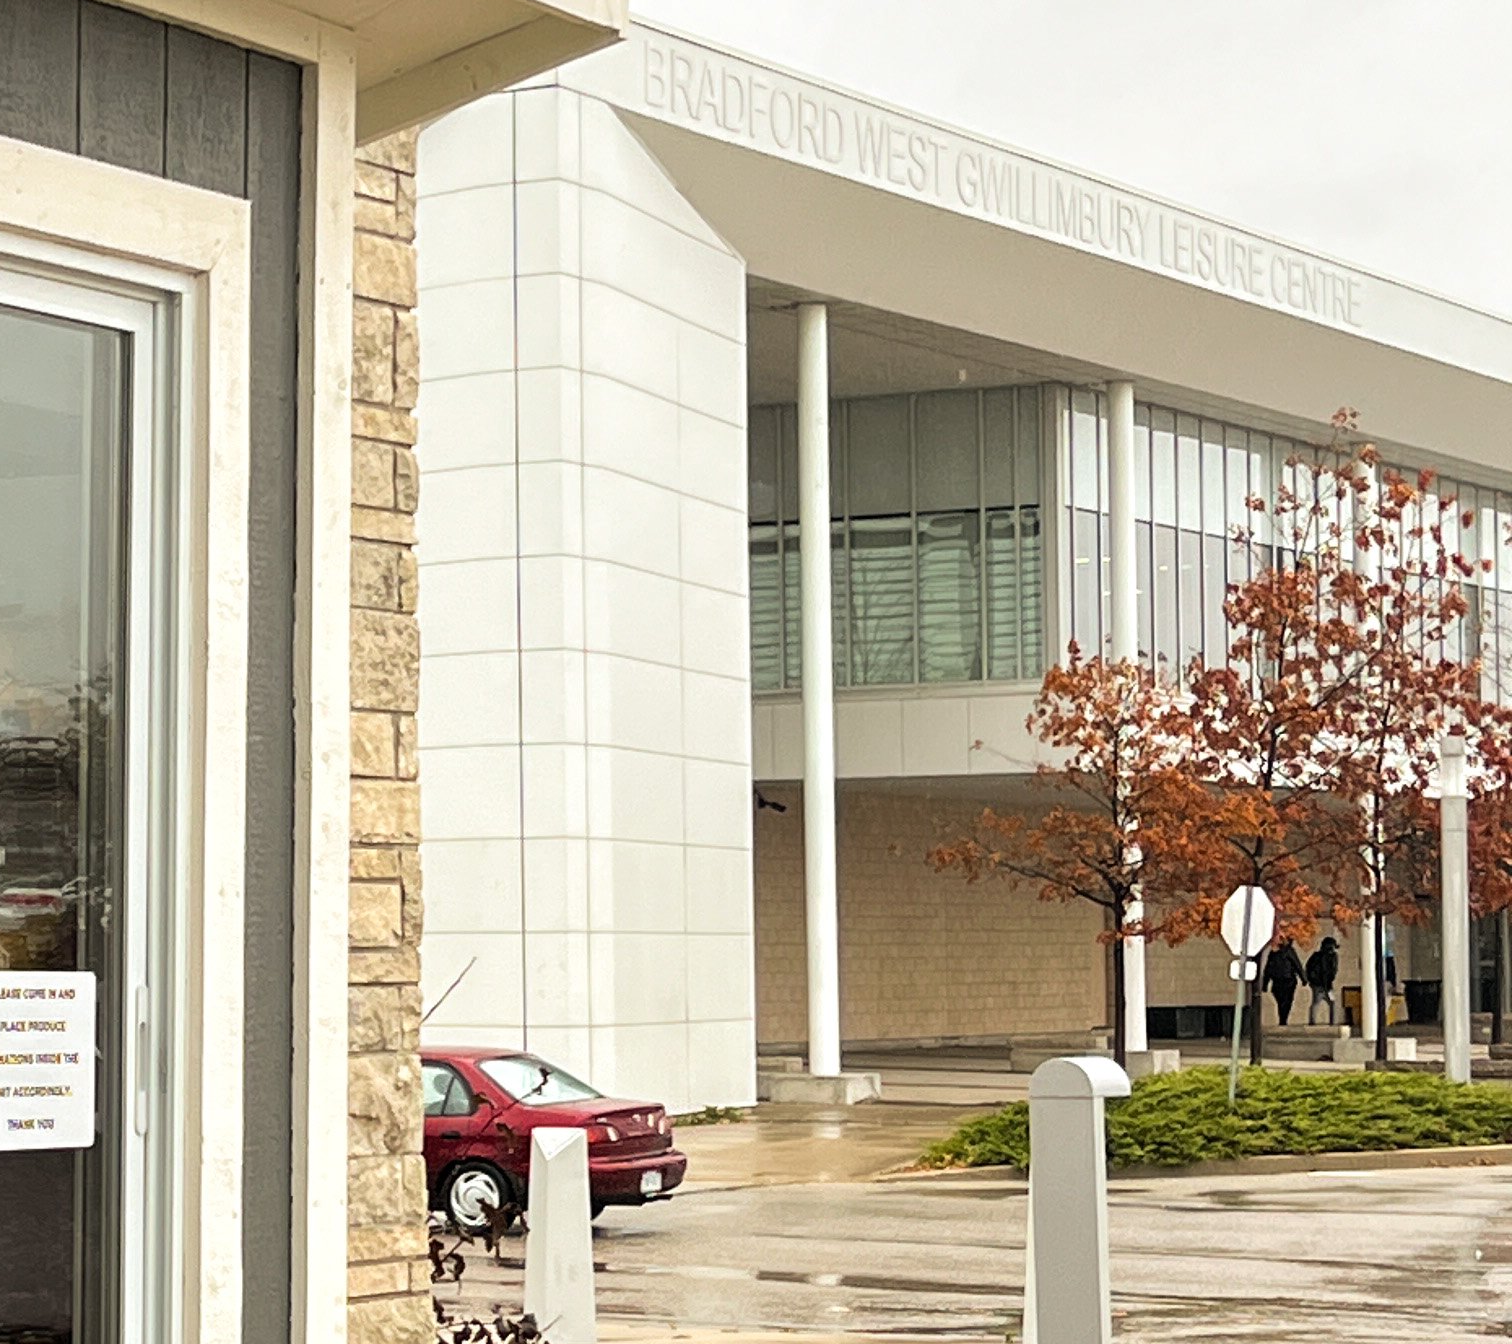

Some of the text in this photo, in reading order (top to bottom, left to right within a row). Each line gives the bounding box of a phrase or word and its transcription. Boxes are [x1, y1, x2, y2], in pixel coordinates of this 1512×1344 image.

[644, 39, 1363, 328] BRADFORD WEST GWILLIMBURY LEISURE CENTRE
[23, 988, 46, 999] COME
[48, 988, 57, 999] IN
[58, 988, 76, 999] AND
[0, 1021, 66, 1032] PLACE PRODUCE
